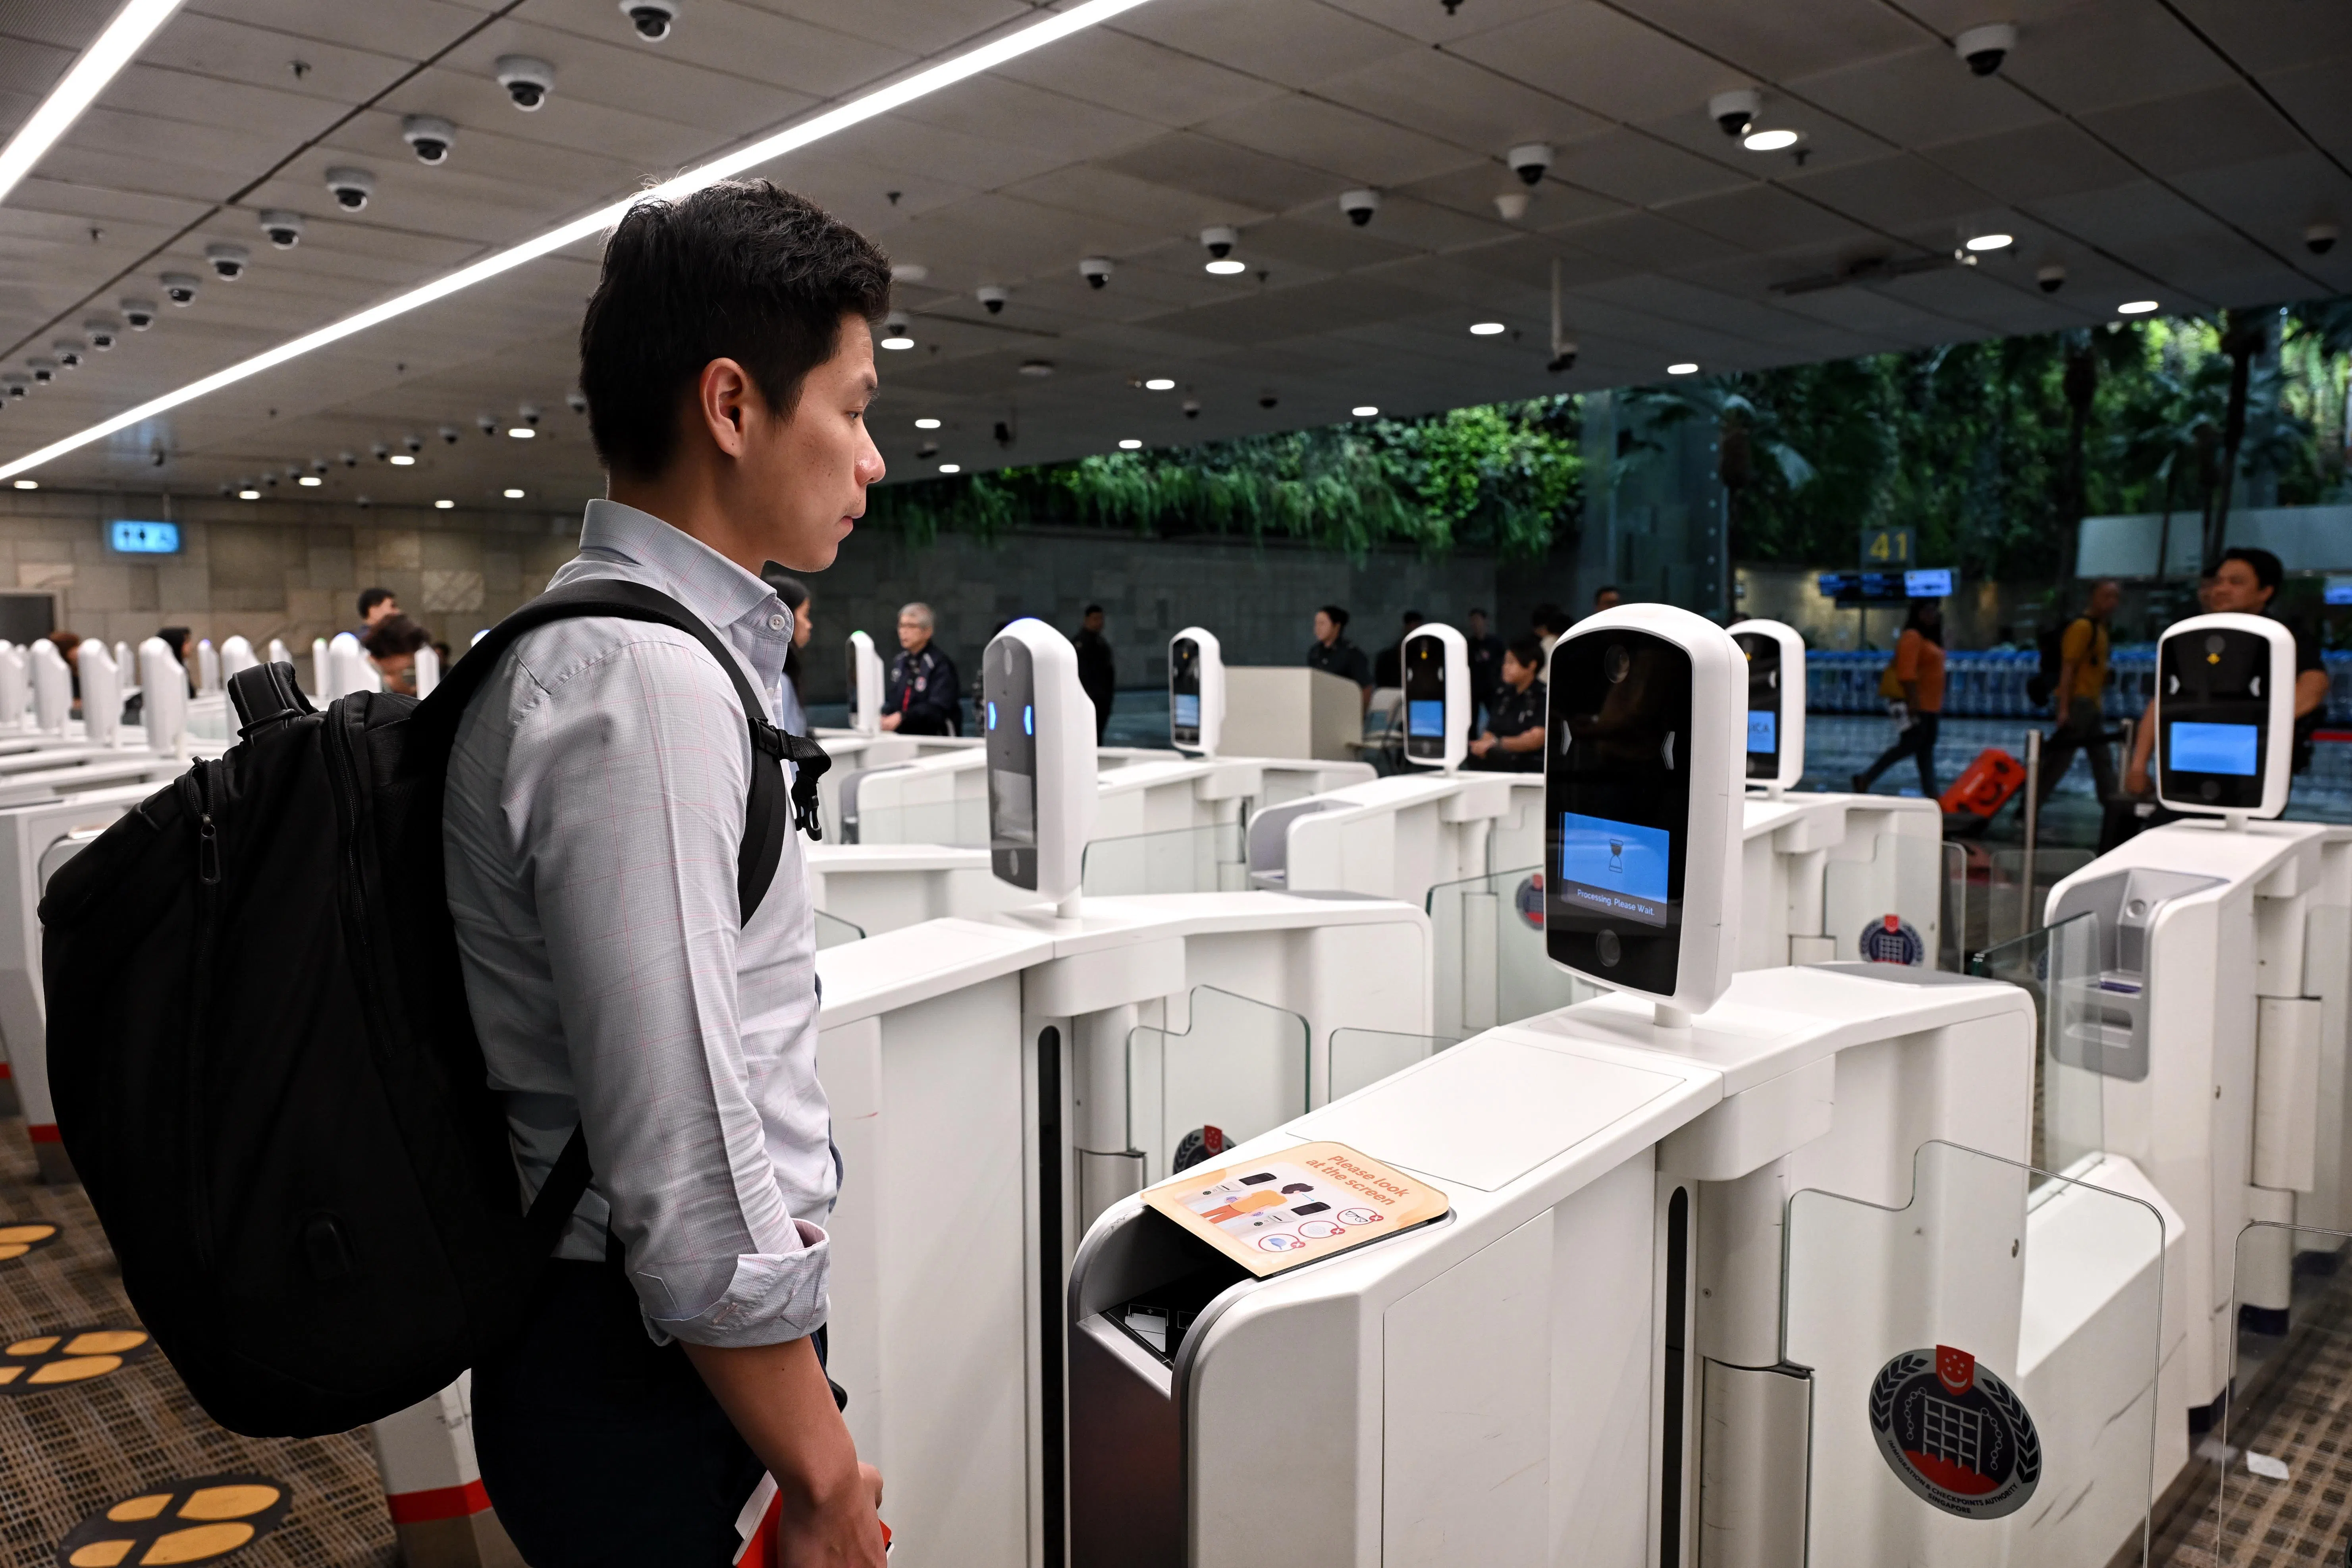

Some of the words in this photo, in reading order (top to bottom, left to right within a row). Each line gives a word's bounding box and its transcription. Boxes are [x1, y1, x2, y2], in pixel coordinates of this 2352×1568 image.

[1869, 532, 1907, 561] 41
[1614, 898, 1636, 911] Please
[1637, 903, 1655, 916] Wait.
[1305, 1160, 1326, 1168] at
[1321, 1167, 1347, 1180] the
[1344, 1180, 1396, 1205] screen
[1327, 1155, 1375, 1180] Please
[1373, 1178, 1410, 1197] look
[1887, 1440, 1925, 1485] IMMIGRATION
[1932, 1488, 1984, 1506] CHECKPOINTS
[1985, 1483, 2018, 1505] AUTHORITY
[1928, 1493, 1971, 1514] SINGAPORE
